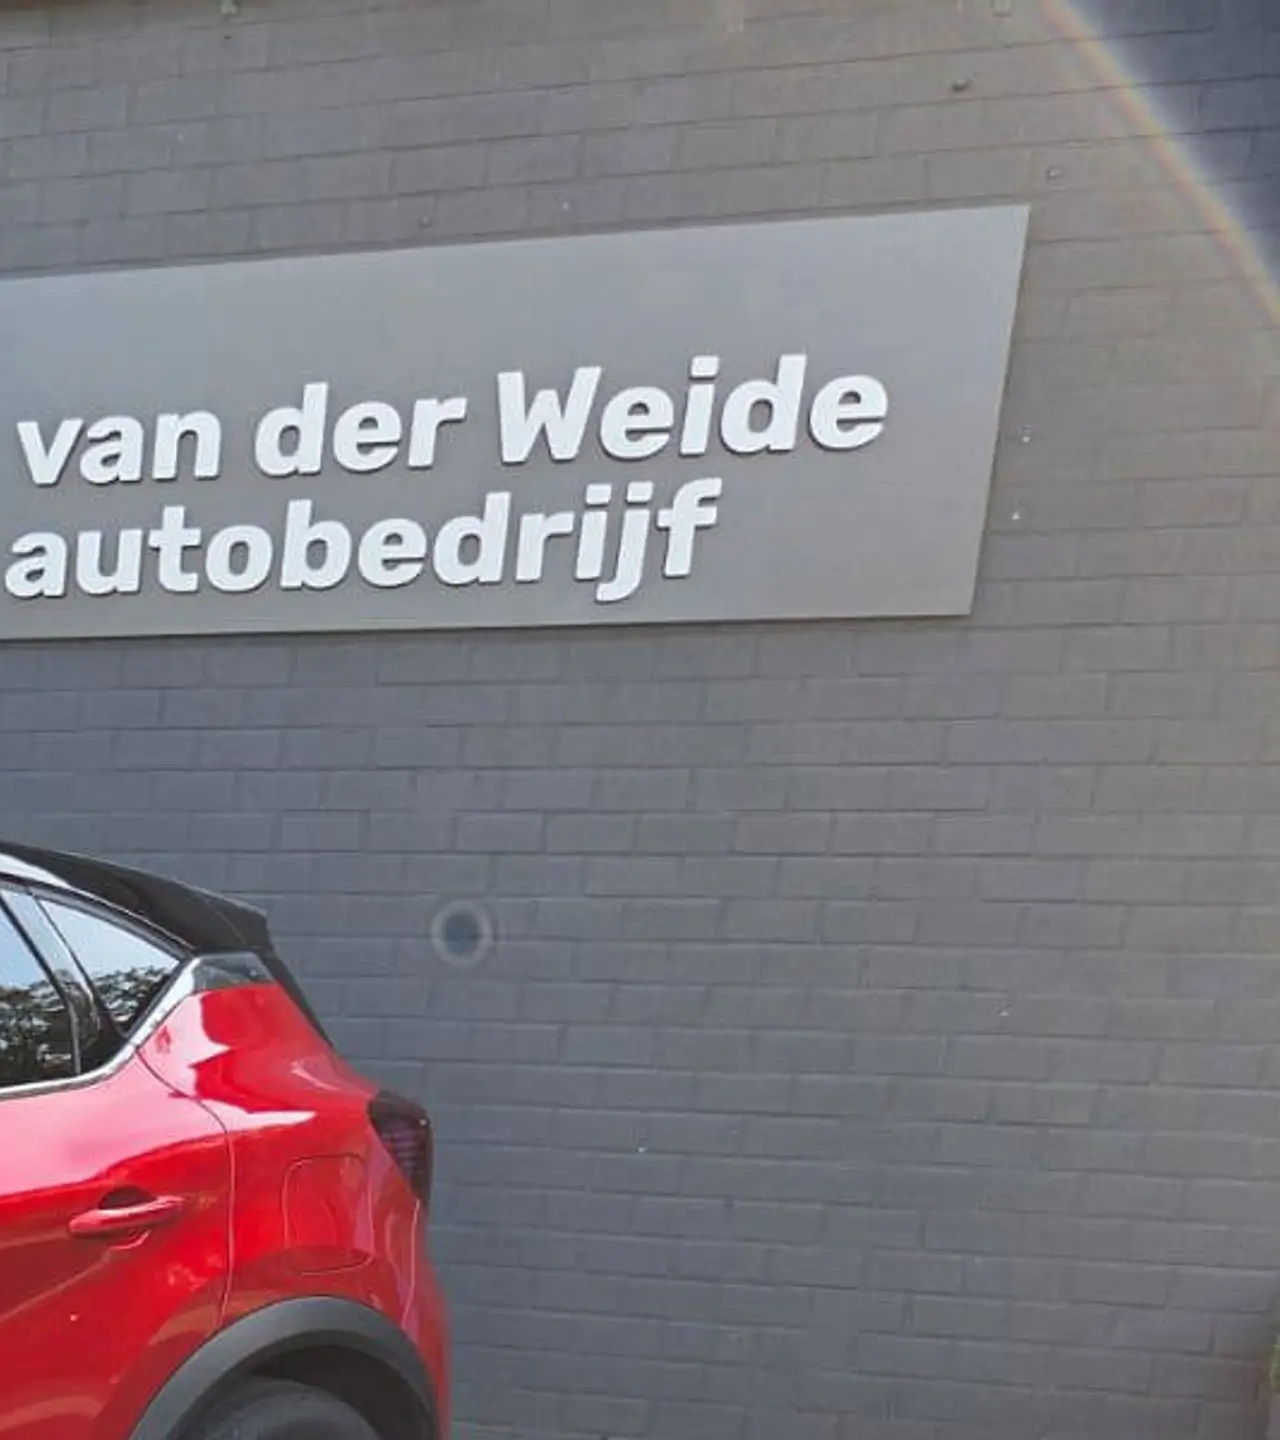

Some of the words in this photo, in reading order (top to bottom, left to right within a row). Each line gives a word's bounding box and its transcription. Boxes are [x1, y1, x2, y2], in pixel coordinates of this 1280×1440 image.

[16, 409, 222, 485] van
[254, 381, 468, 476] der
[497, 353, 889, 464] Weide
[3, 476, 723, 602] autobedrijf
